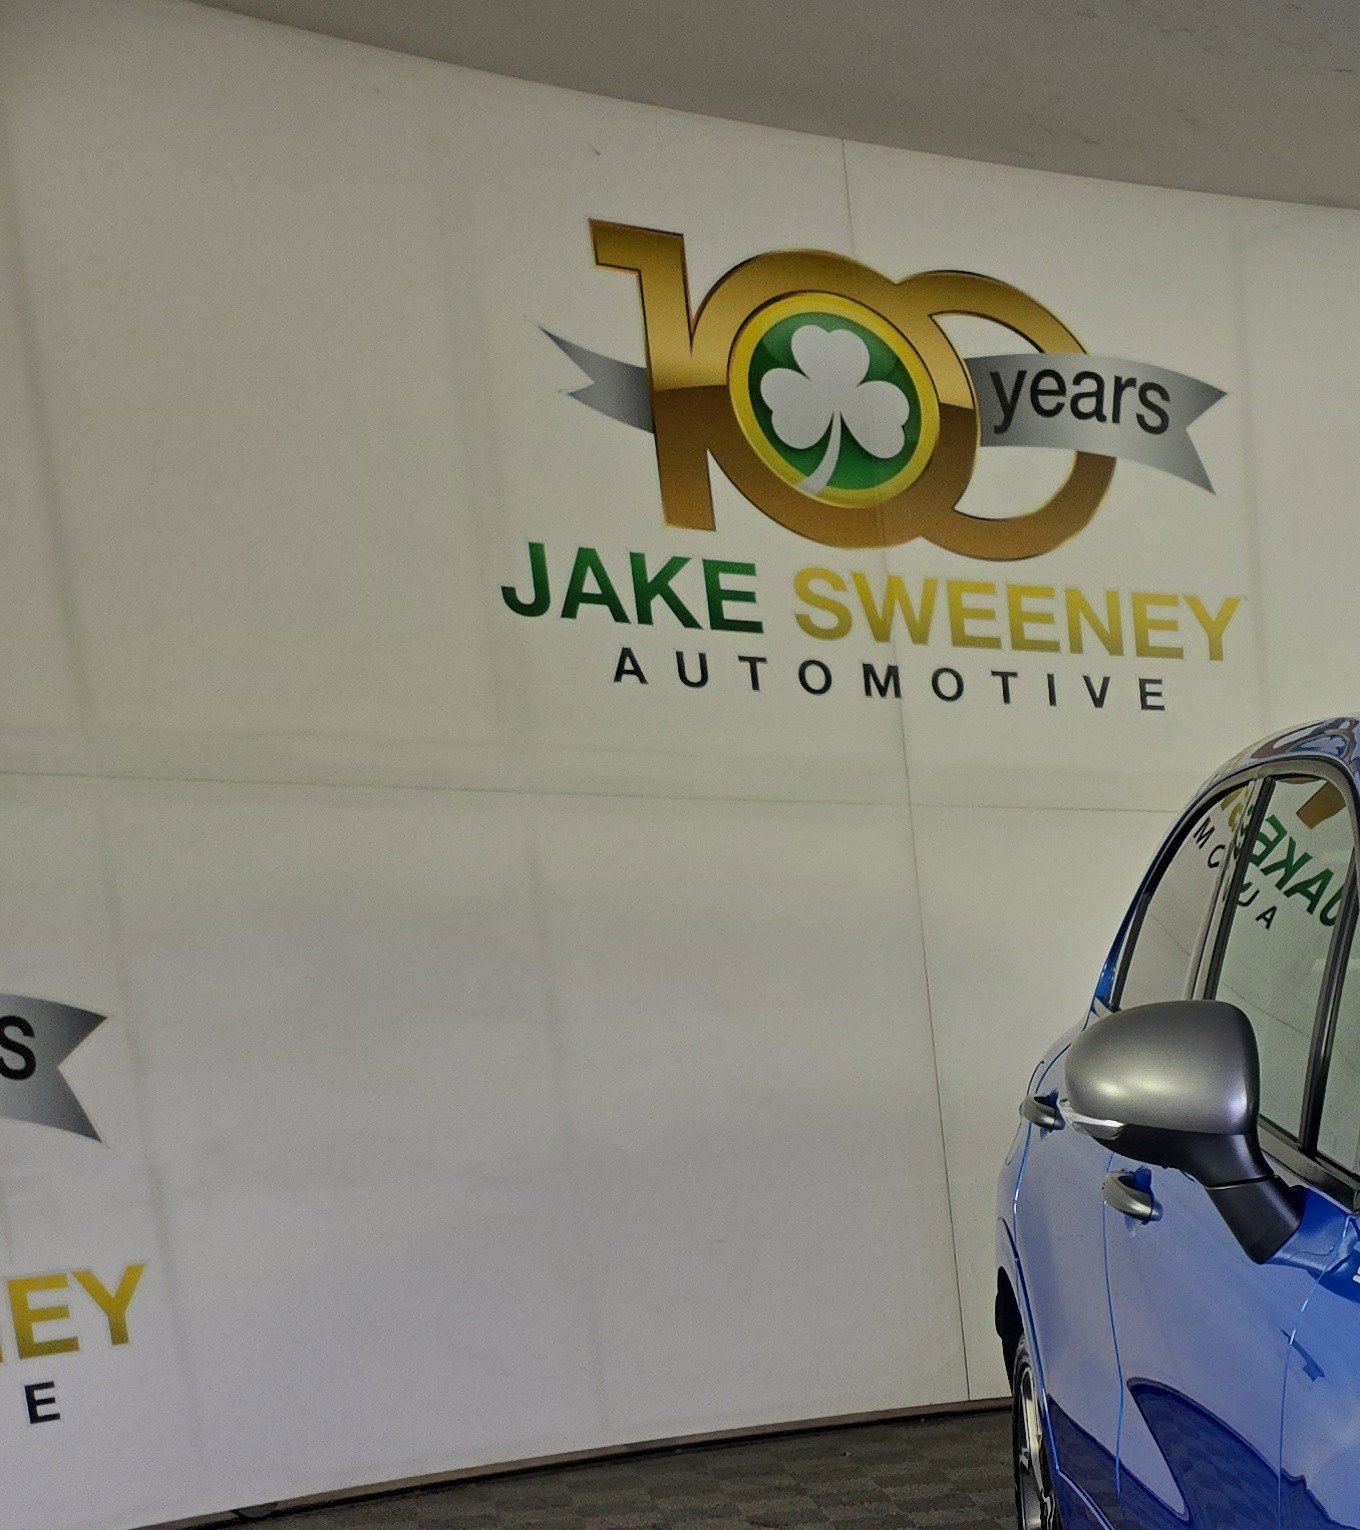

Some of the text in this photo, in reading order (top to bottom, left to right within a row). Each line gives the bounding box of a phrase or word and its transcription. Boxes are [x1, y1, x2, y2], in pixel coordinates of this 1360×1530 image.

[589, 218, 1171, 562] 100 years
[501, 542, 1241, 662] JAKE SWEENEY
[613, 646, 1167, 711] AUTOMOTIVE
